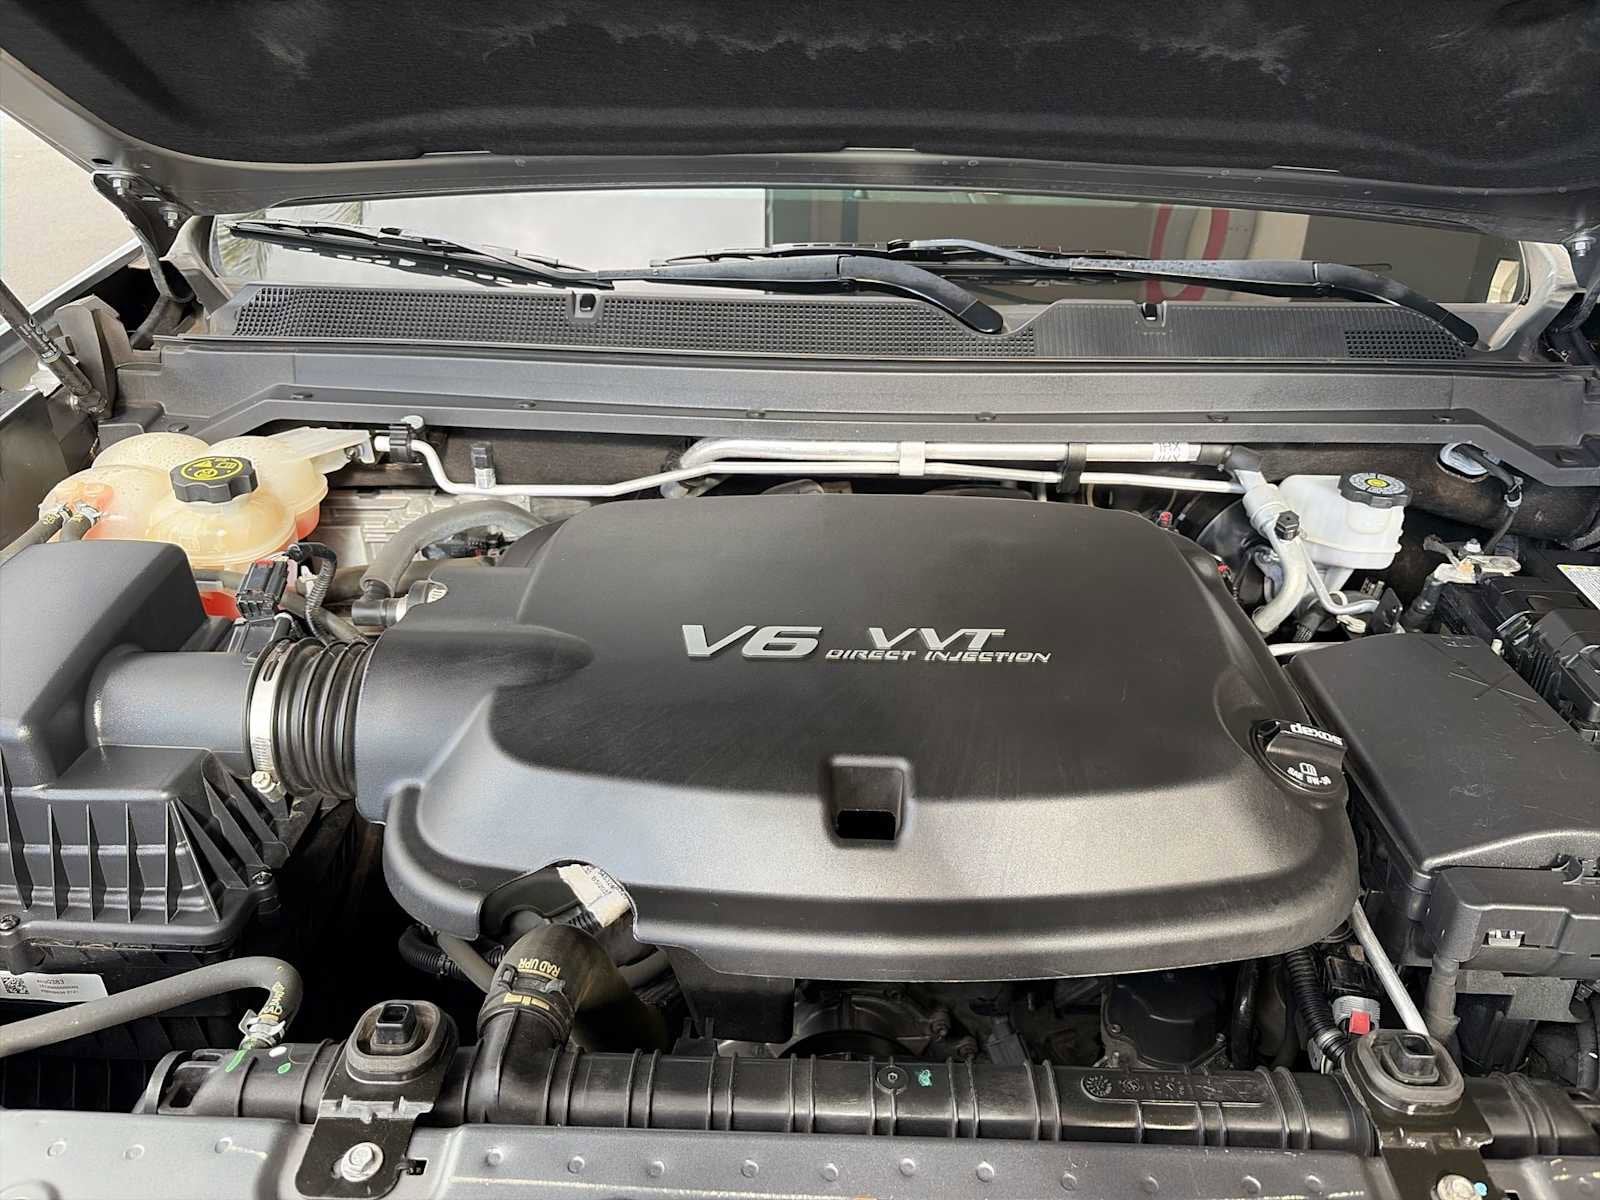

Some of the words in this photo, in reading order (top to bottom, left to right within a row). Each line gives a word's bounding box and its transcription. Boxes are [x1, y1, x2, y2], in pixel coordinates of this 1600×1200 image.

[681, 624, 823, 658] V6
[867, 626, 1006, 650] VVT
[824, 647, 916, 661] DIRECT
[924, 649, 1053, 663] INJECTION
[1290, 722, 1343, 746] dexos
[518, 957, 539, 970] UPR
[540, 960, 561, 977] RAD
